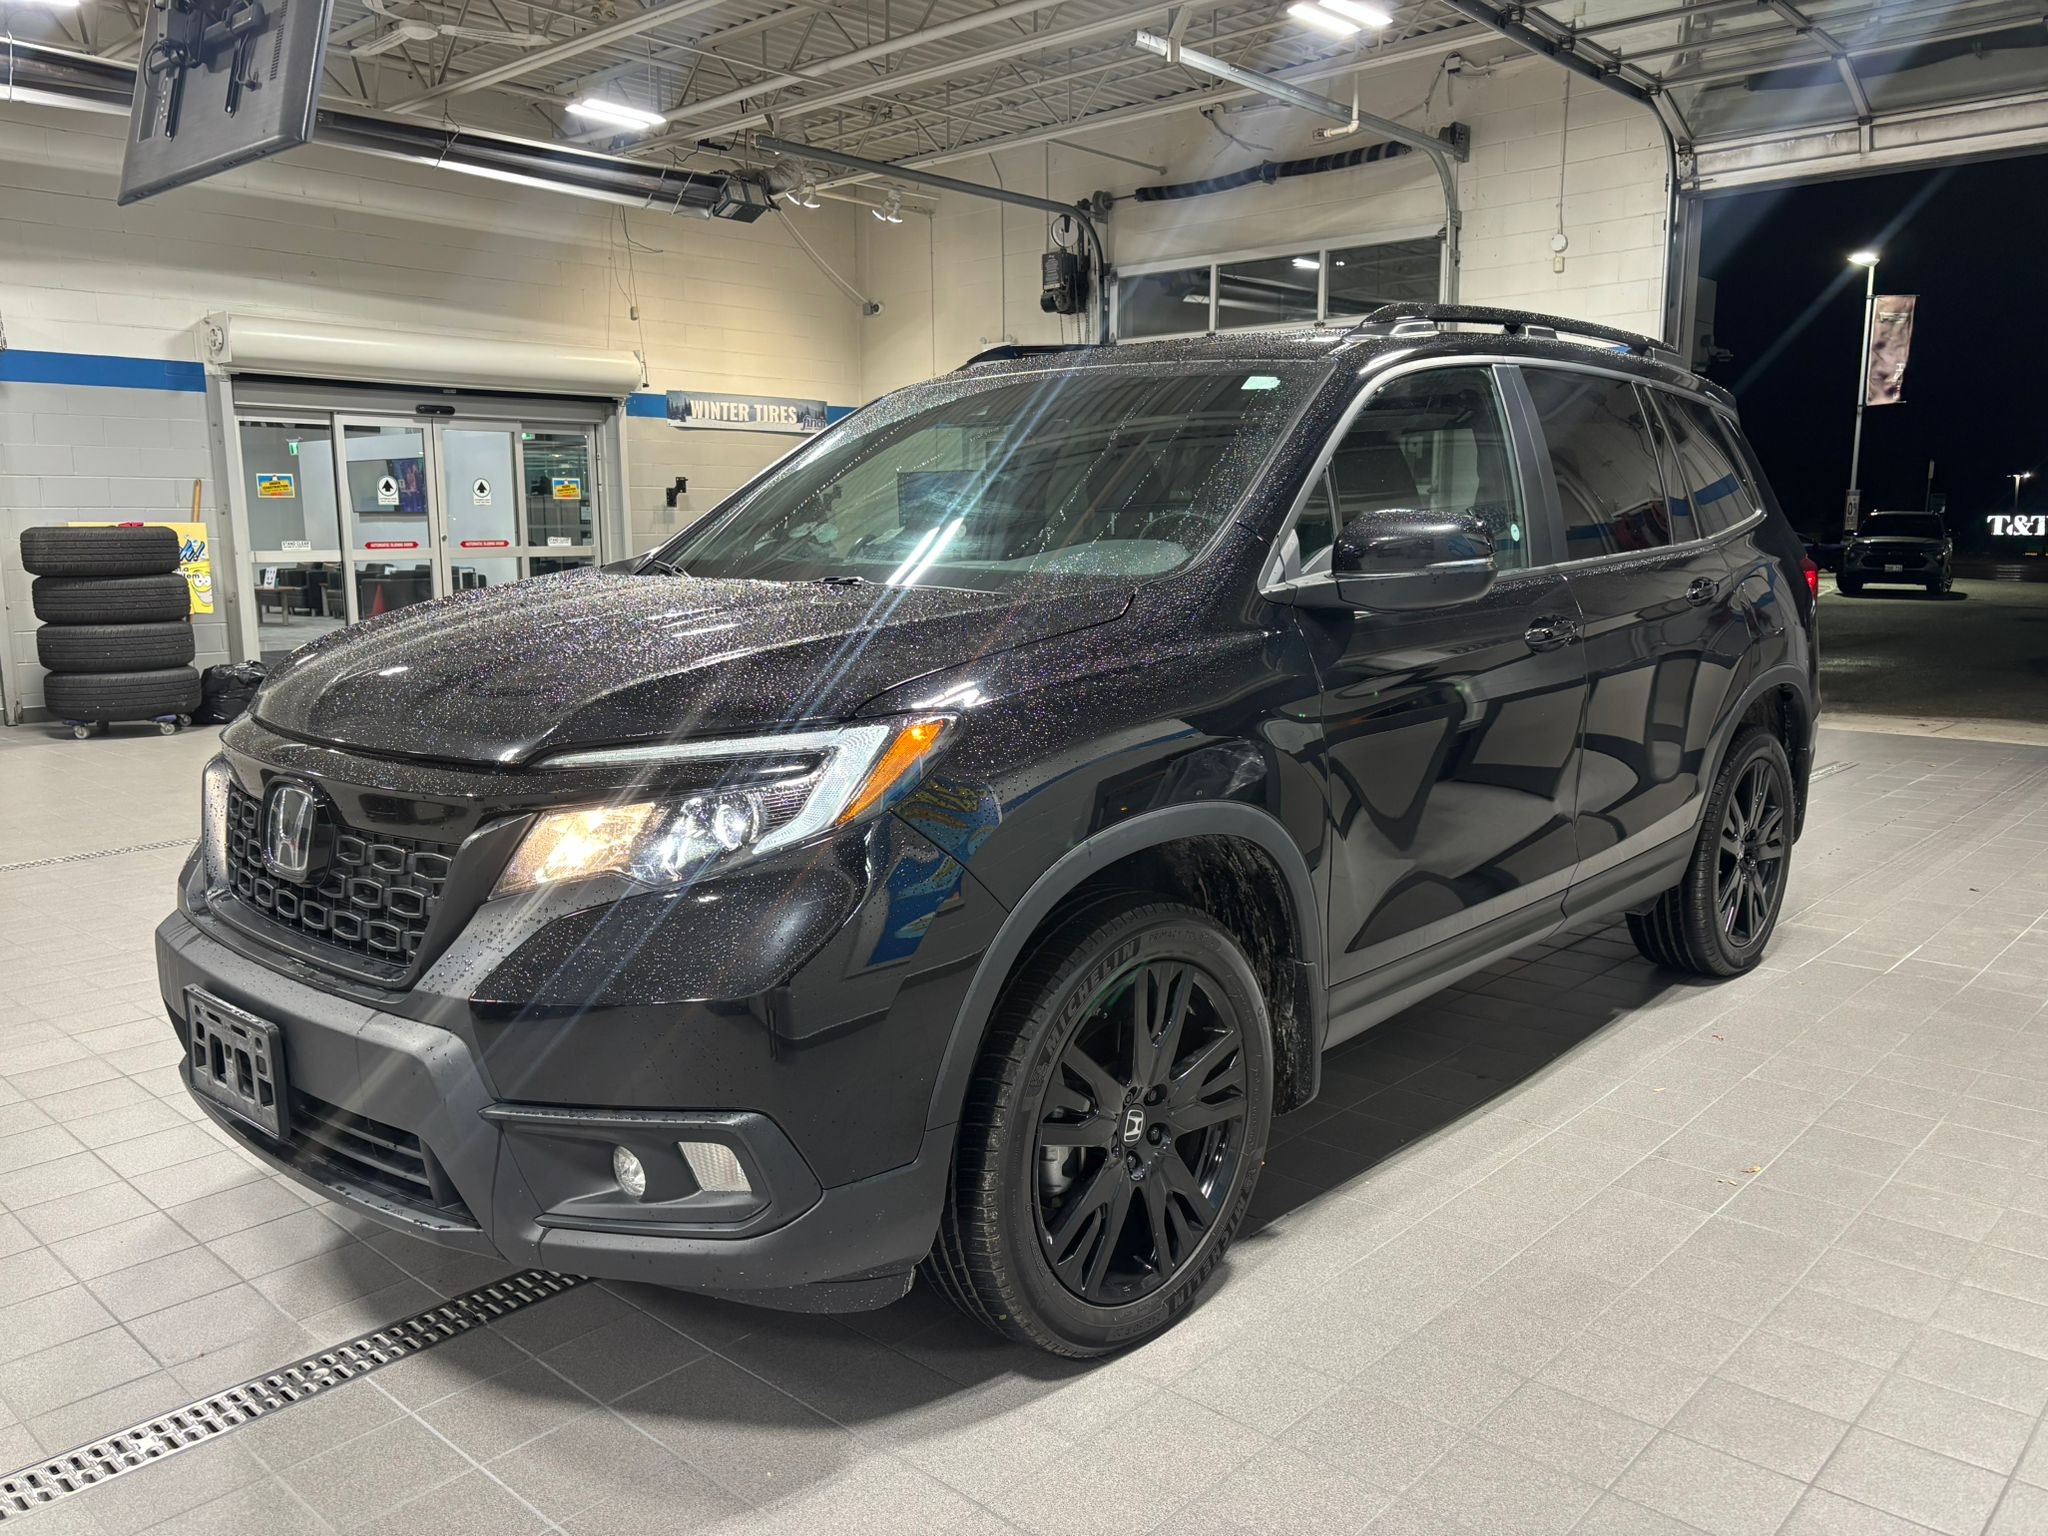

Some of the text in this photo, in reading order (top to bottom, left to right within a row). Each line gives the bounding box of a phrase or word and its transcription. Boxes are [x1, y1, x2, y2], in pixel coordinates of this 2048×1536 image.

[690, 399, 798, 425] WINTER TIRES
[1986, 514, 2048, 536] T&T
[1045, 940, 1137, 1057] MICHELIN
